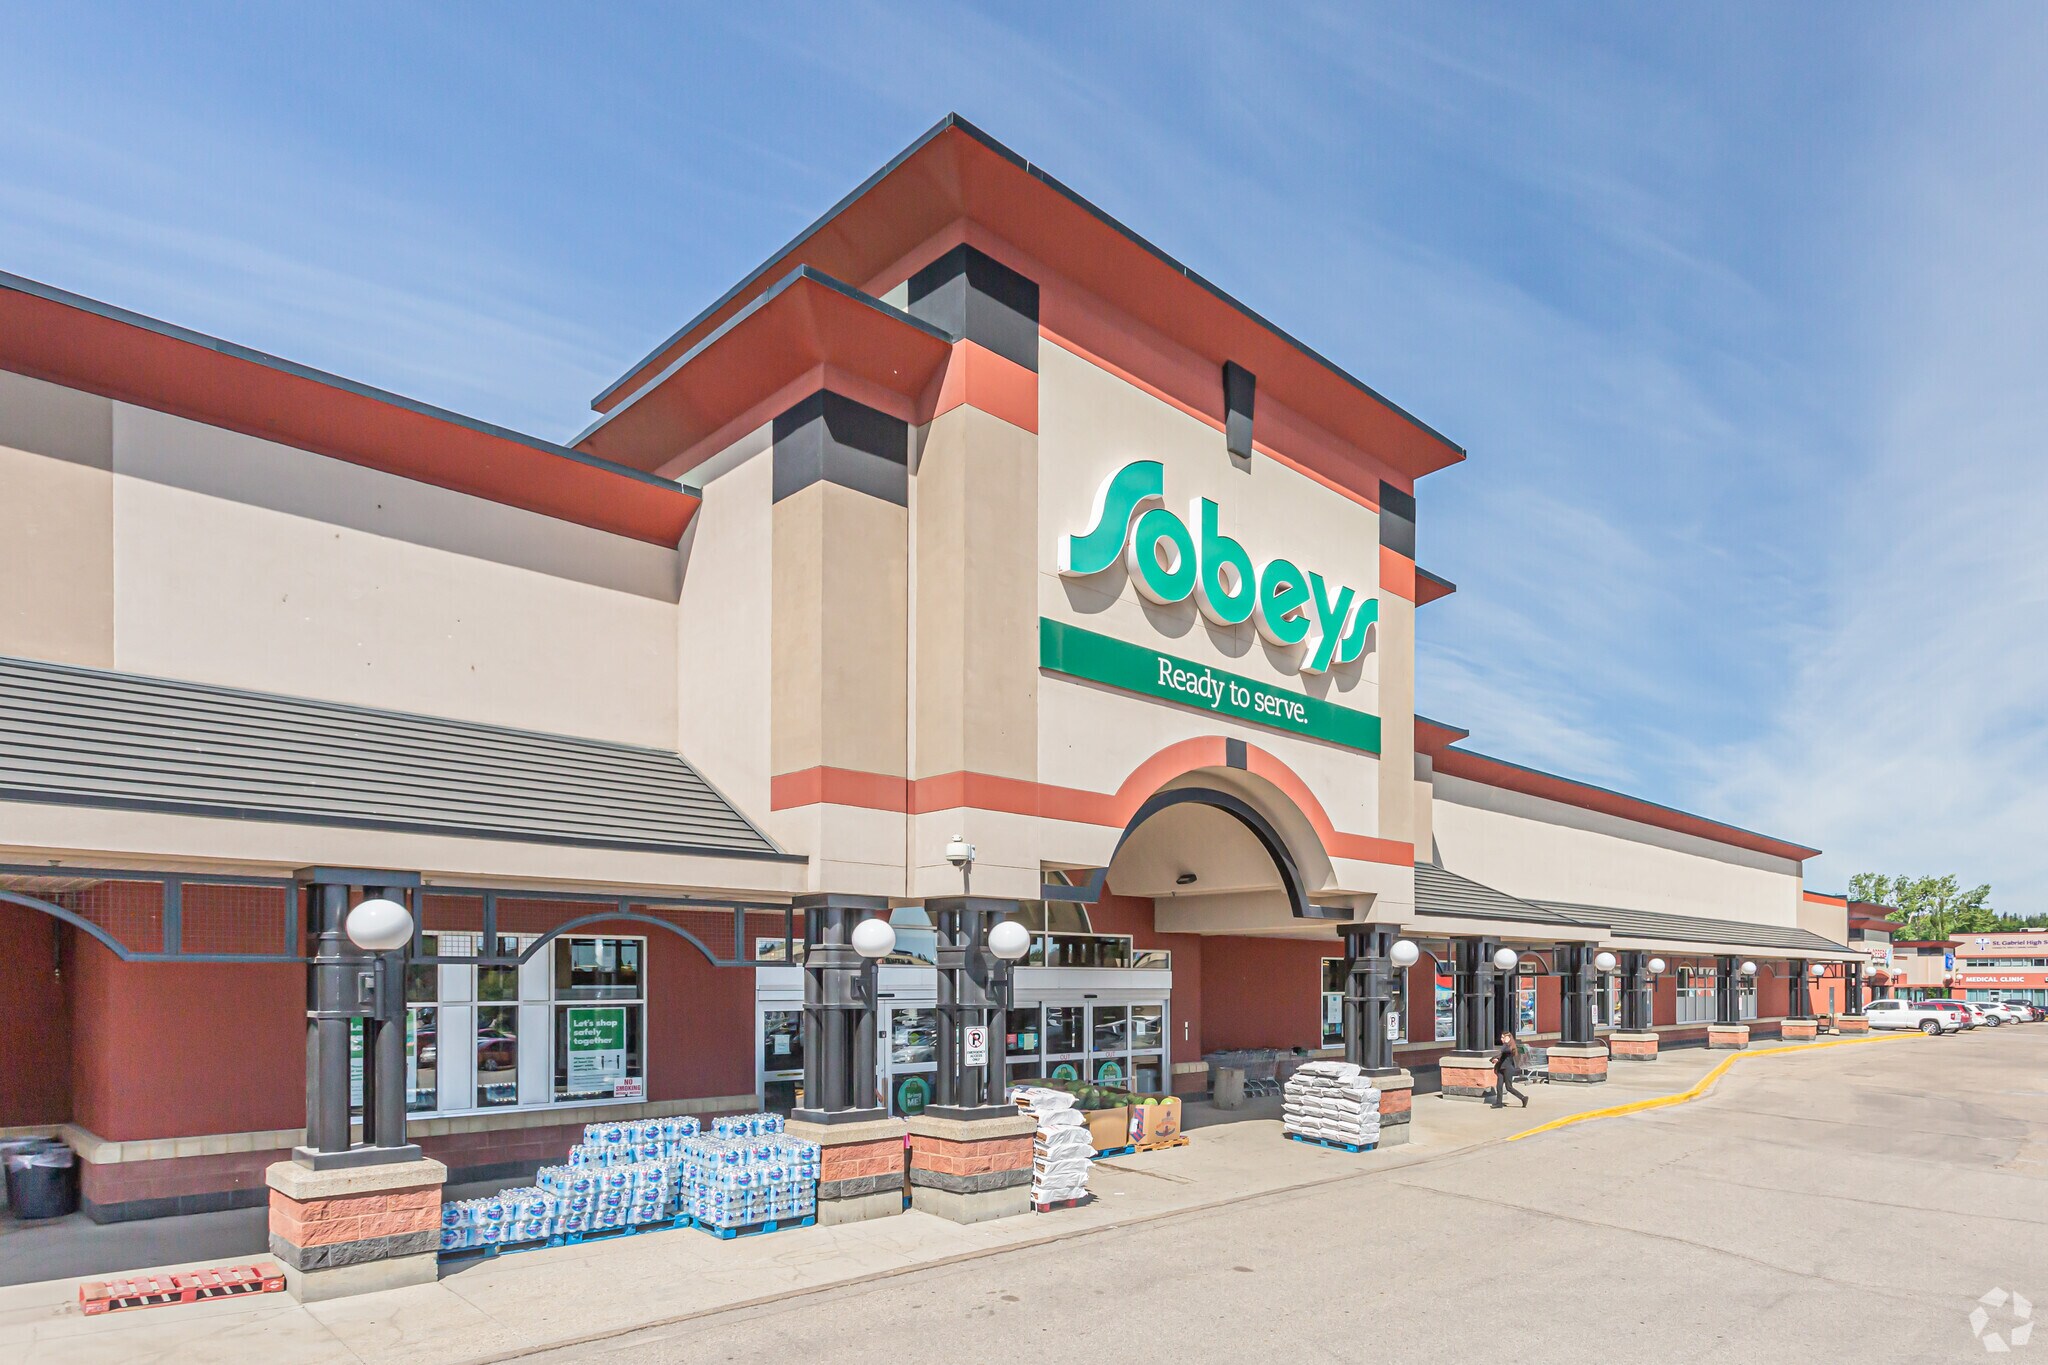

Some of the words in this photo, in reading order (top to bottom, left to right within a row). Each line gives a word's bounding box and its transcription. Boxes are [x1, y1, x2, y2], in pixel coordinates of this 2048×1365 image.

[1060, 460, 1379, 674] Sobeys
[1157, 657, 1226, 708] Ready
[1229, 680, 1251, 707] to
[1254, 695, 1309, 724] serve.
[573, 1020, 594, 1028] Let's
[596, 1019, 618, 1028] shop
[573, 1029, 602, 1037] safely
[573, 1038, 613, 1047] together
